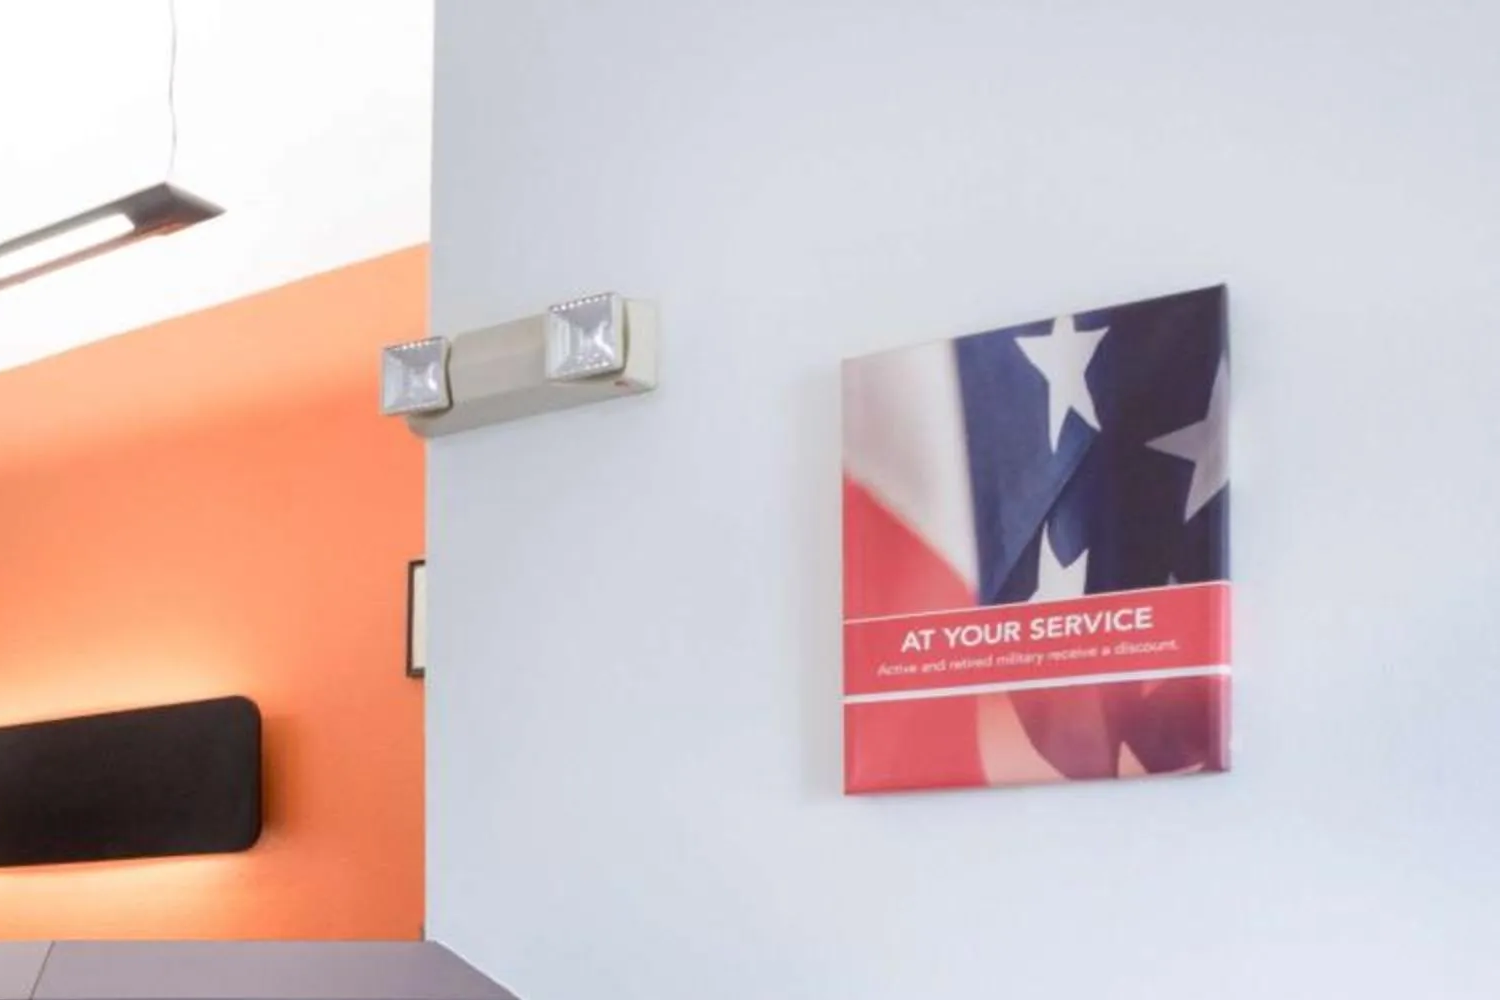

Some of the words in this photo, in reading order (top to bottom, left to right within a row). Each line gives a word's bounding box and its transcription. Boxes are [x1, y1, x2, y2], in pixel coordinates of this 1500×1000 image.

[900, 628, 936, 653] AT
[941, 620, 1021, 650] YOUR
[1029, 606, 1155, 641] SERVICE
[877, 662, 917, 676] Active
[921, 659, 947, 673] and
[949, 654, 993, 669] retired
[996, 648, 1044, 666] military
[1048, 648, 1097, 661] receive
[1101, 646, 1111, 656] a
[1114, 639, 1180, 656] discount.
